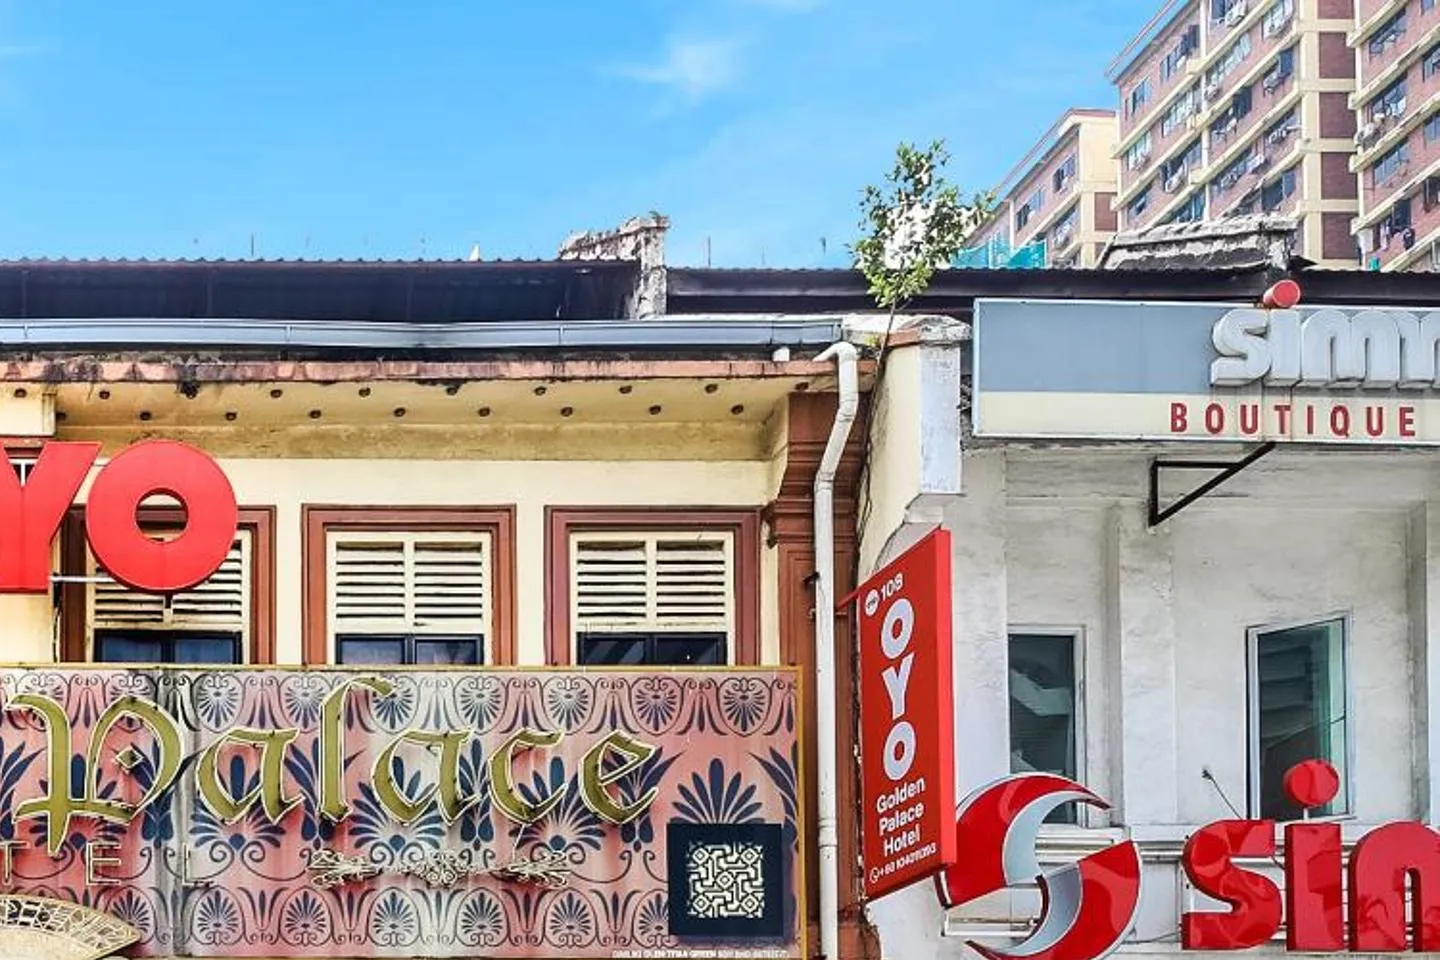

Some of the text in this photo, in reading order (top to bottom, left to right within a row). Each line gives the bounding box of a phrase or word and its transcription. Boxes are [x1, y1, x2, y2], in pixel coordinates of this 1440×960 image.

[1170, 402, 1417, 438] BOUTIQUE
[880, 598, 916, 781] OYO
[5, 674, 660, 858] Palace
[876, 777, 926, 814] Golden
[879, 802, 925, 836] Palace
[884, 823, 921, 857] Hotel
